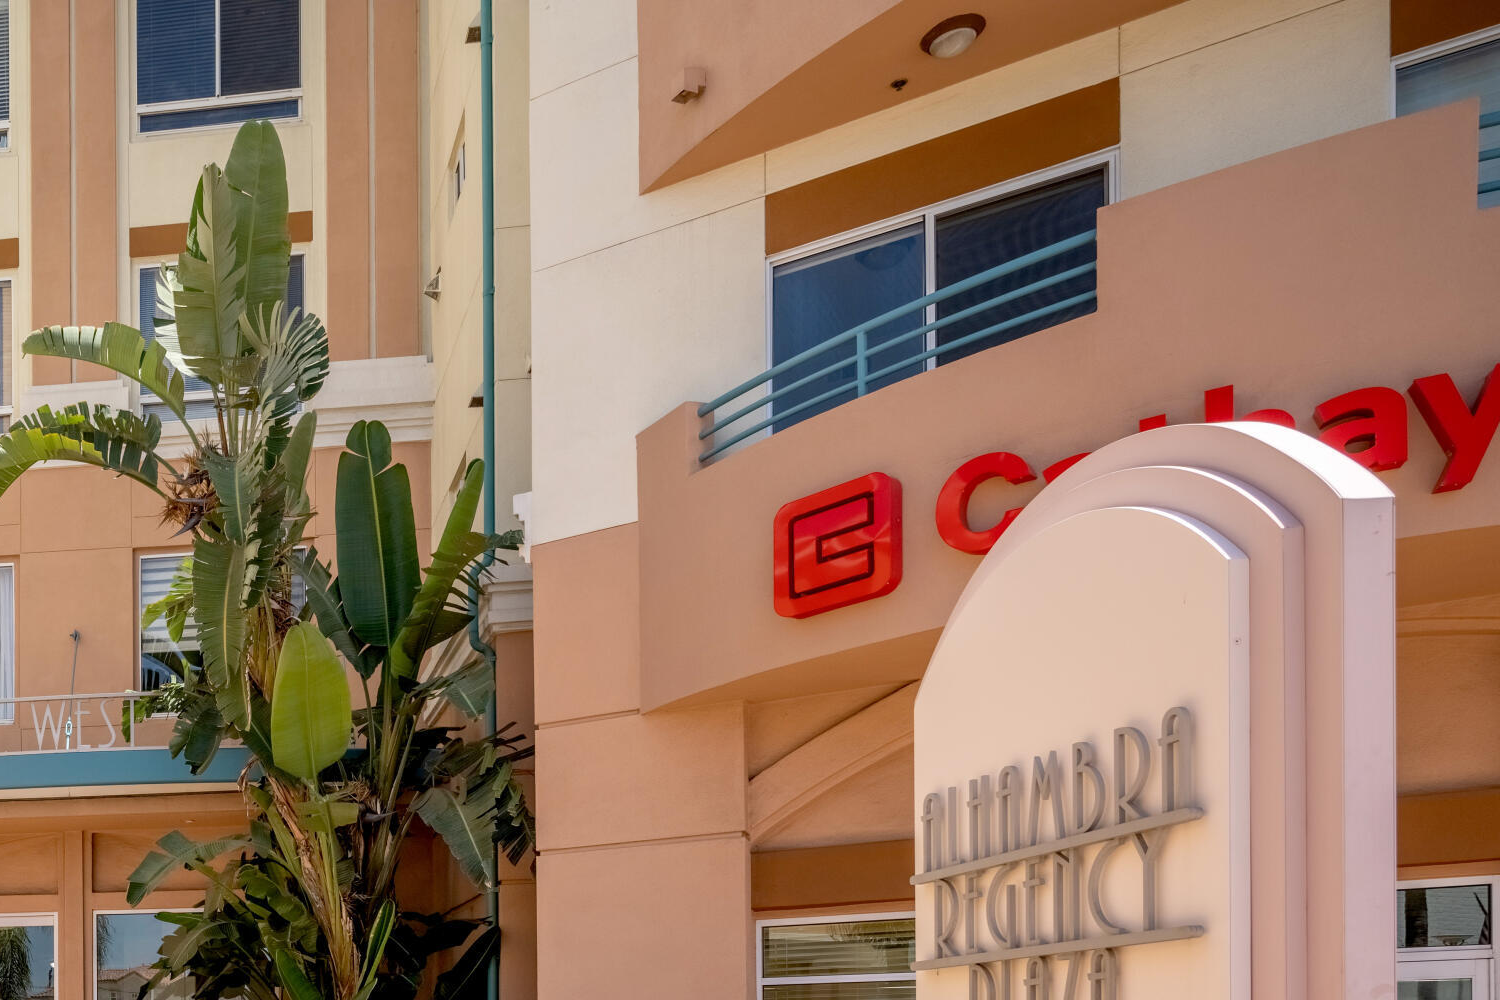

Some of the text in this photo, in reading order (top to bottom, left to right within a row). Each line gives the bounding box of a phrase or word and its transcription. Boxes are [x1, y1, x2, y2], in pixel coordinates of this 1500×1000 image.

[936, 362, 1500, 555] Cay
[31, 697, 140, 751] WEST
[921, 706, 1193, 873] ALHAMBRA
[935, 827, 1170, 958] REGENCY
